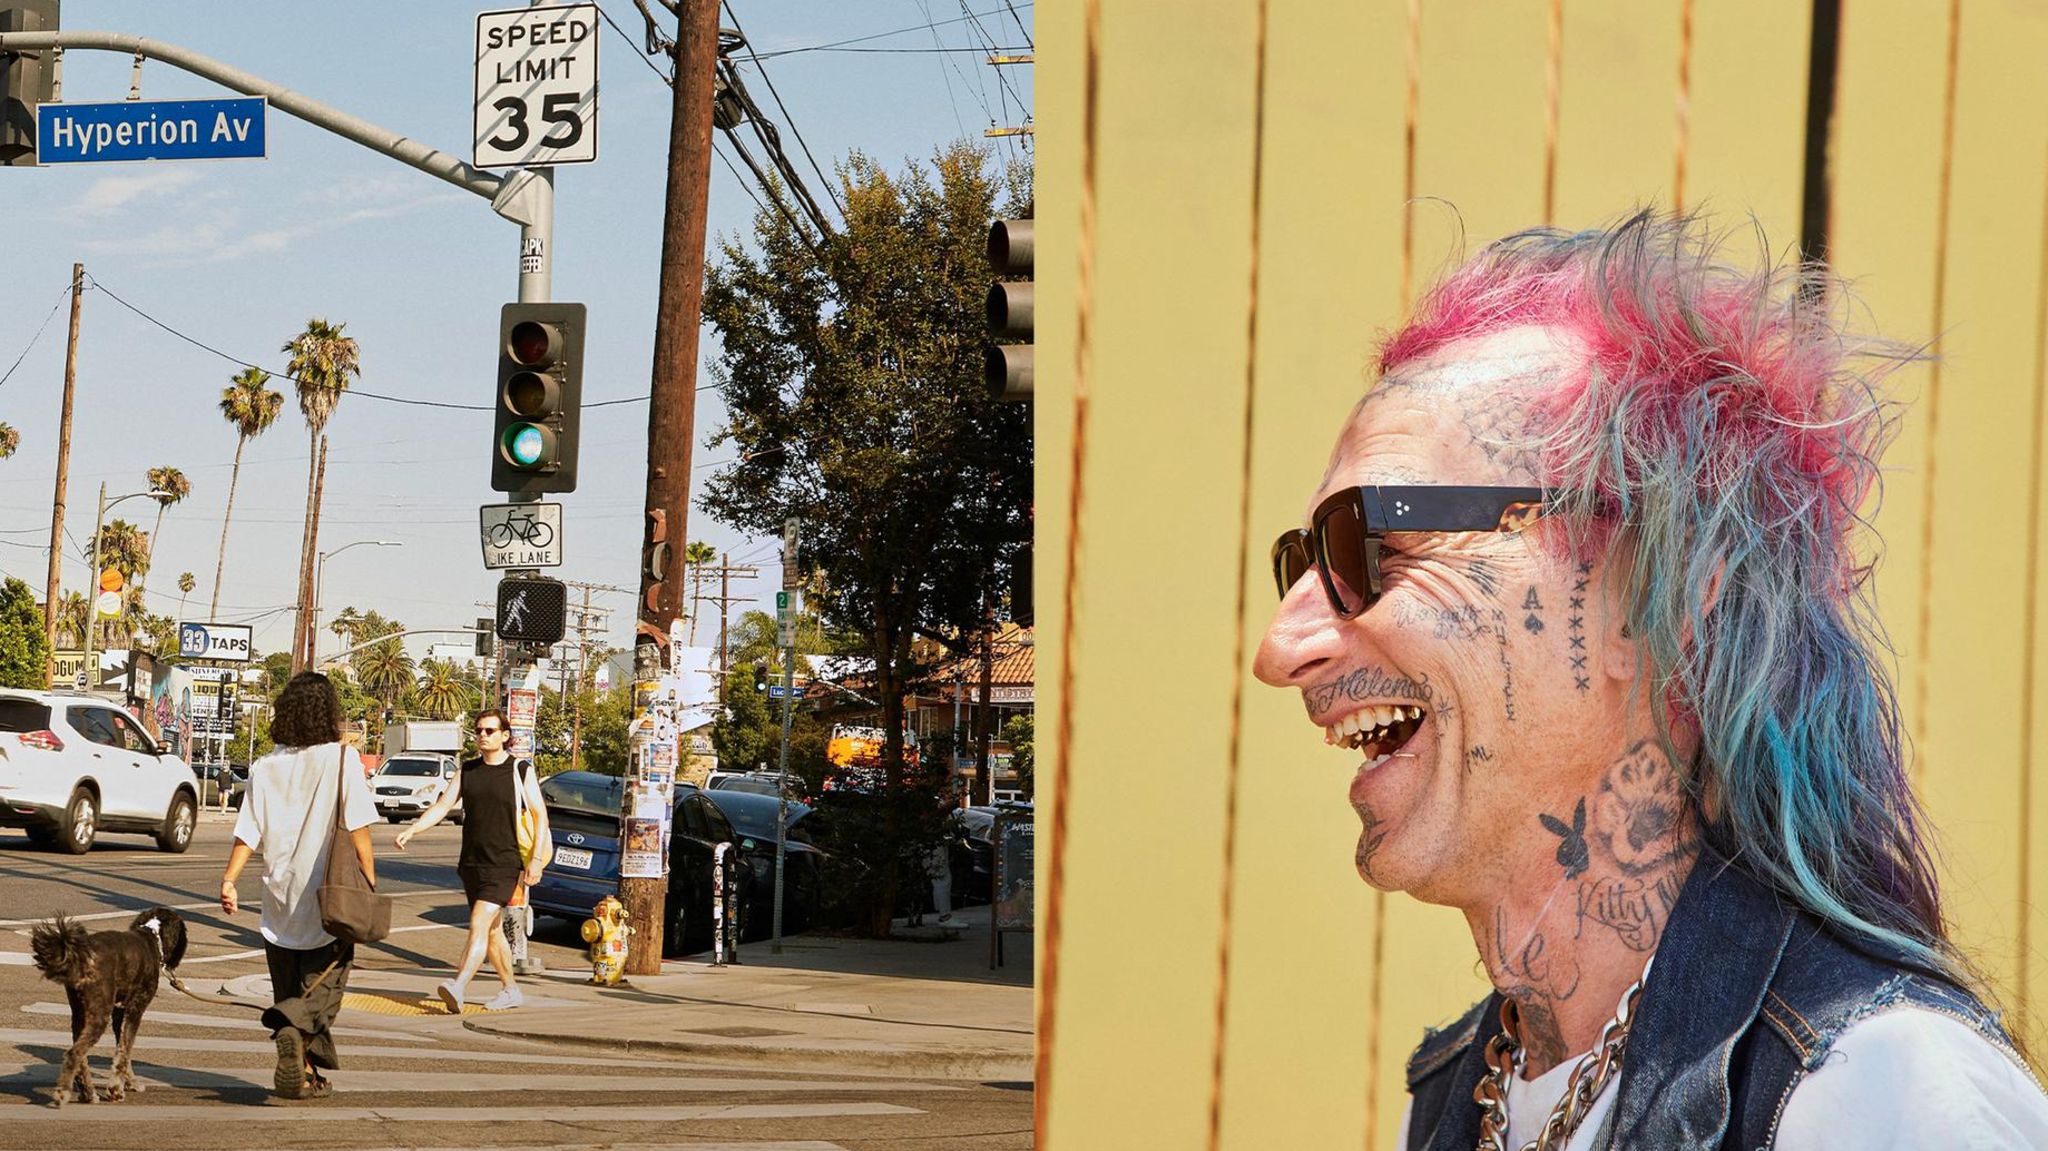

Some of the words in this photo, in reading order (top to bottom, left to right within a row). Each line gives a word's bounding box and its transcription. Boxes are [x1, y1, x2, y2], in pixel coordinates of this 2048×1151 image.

[487, 20, 588, 49] SPEED
[496, 56, 576, 84] LIMIT
[53, 113, 197, 155] Hyperion
[211, 111, 251, 143] Av
[488, 92, 583, 152] 35
[491, 551, 514, 565] IKE
[520, 551, 551, 564] LANE
[183, 629, 206, 654] 33
[211, 637, 248, 652] TAPS
